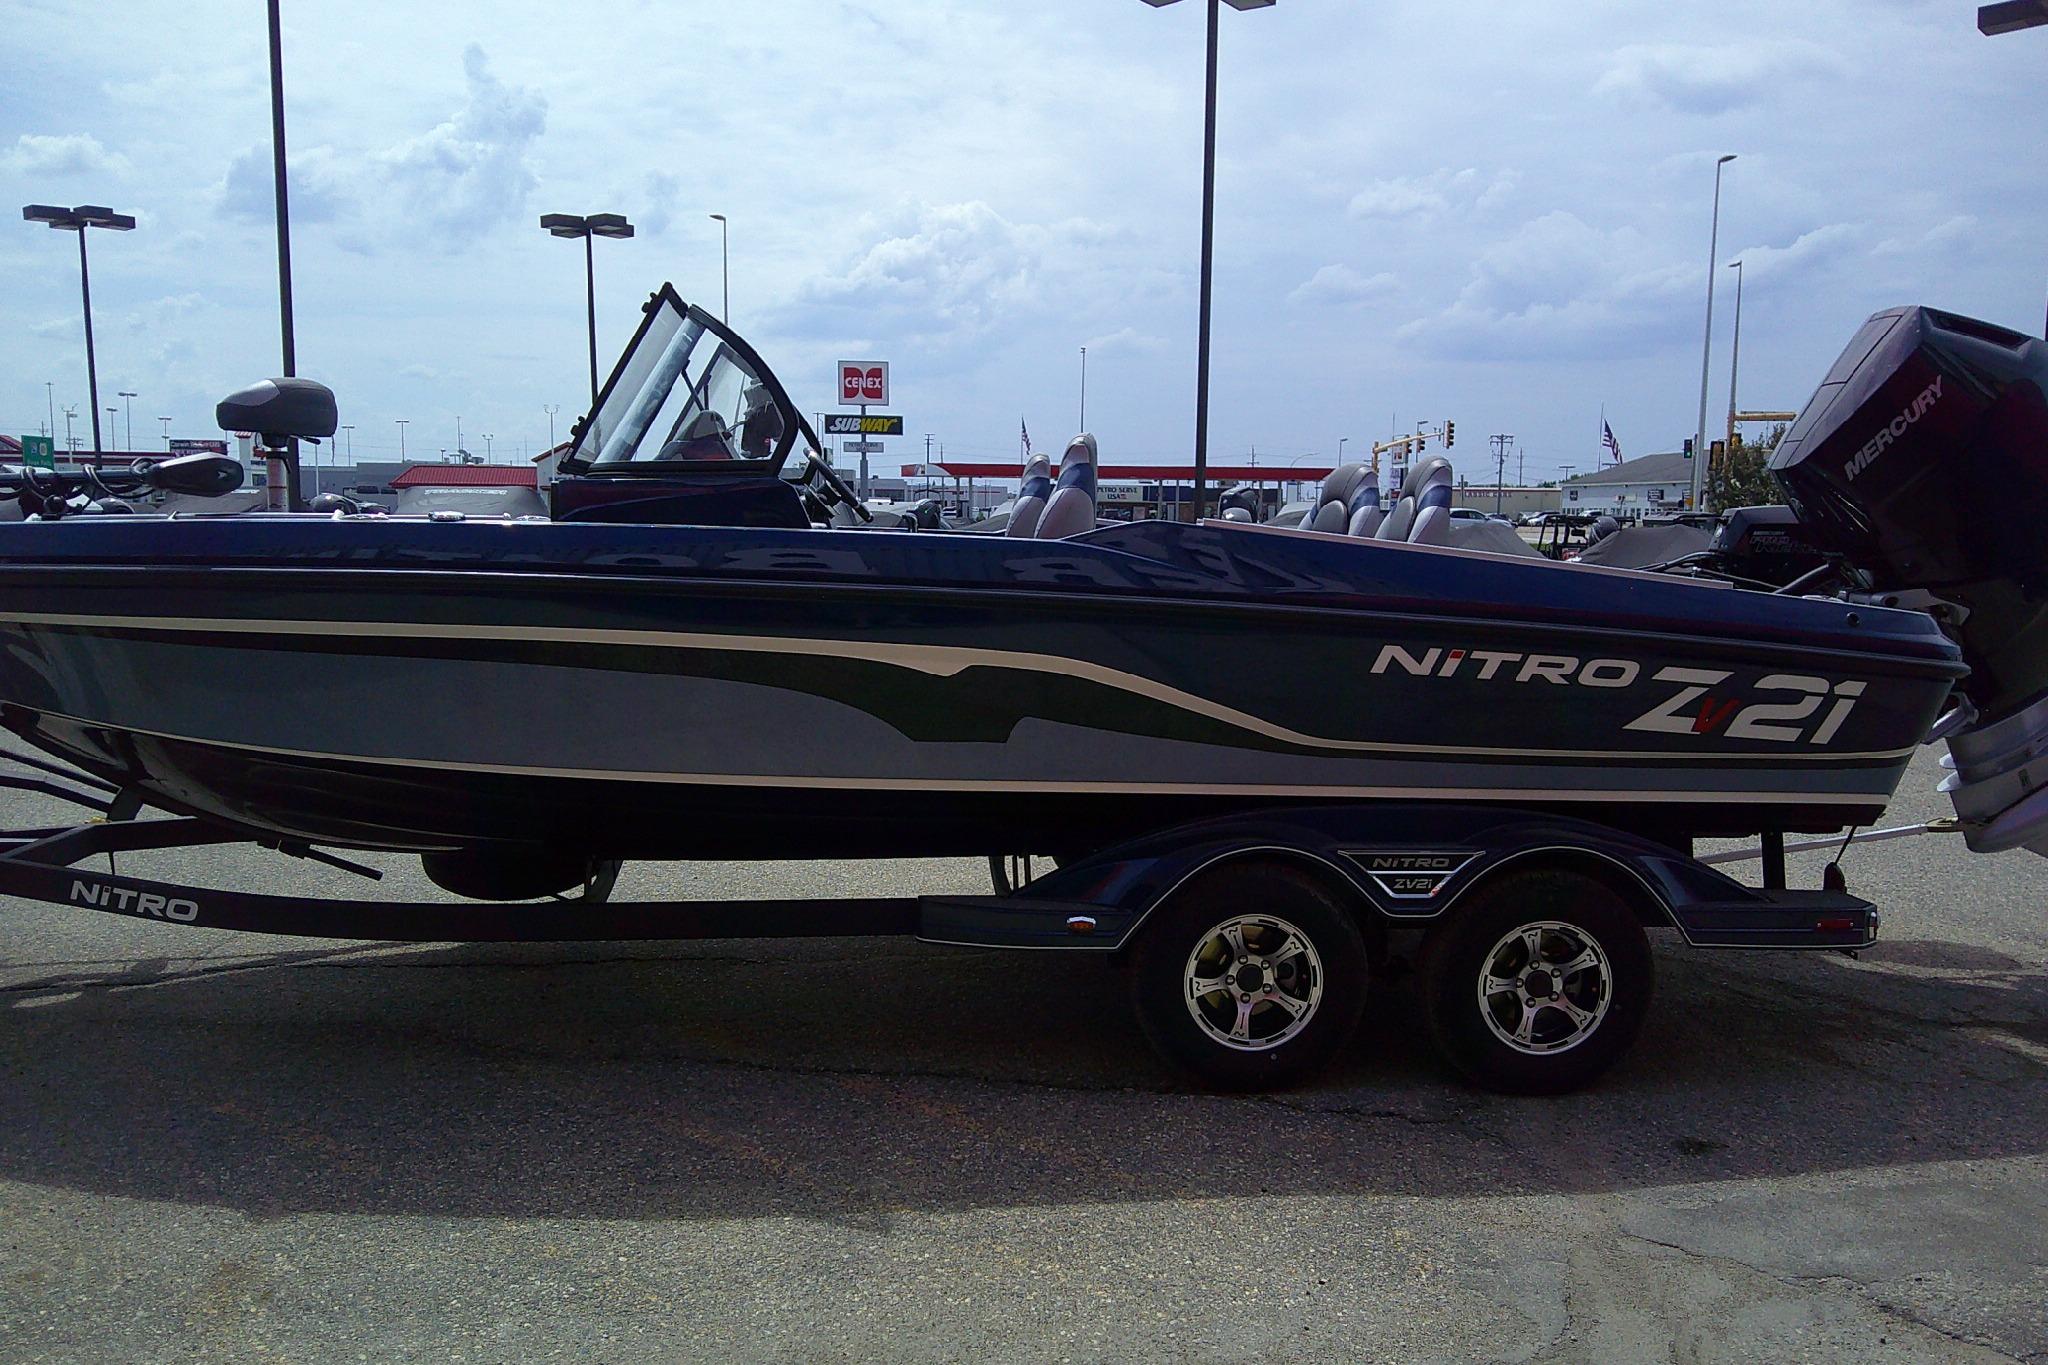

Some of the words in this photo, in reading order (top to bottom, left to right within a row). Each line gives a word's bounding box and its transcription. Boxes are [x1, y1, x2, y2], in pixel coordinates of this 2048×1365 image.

[844, 377, 882, 388] CENEX
[829, 417, 898, 432] SUBWAY
[1843, 374, 1944, 482] MERCURY
